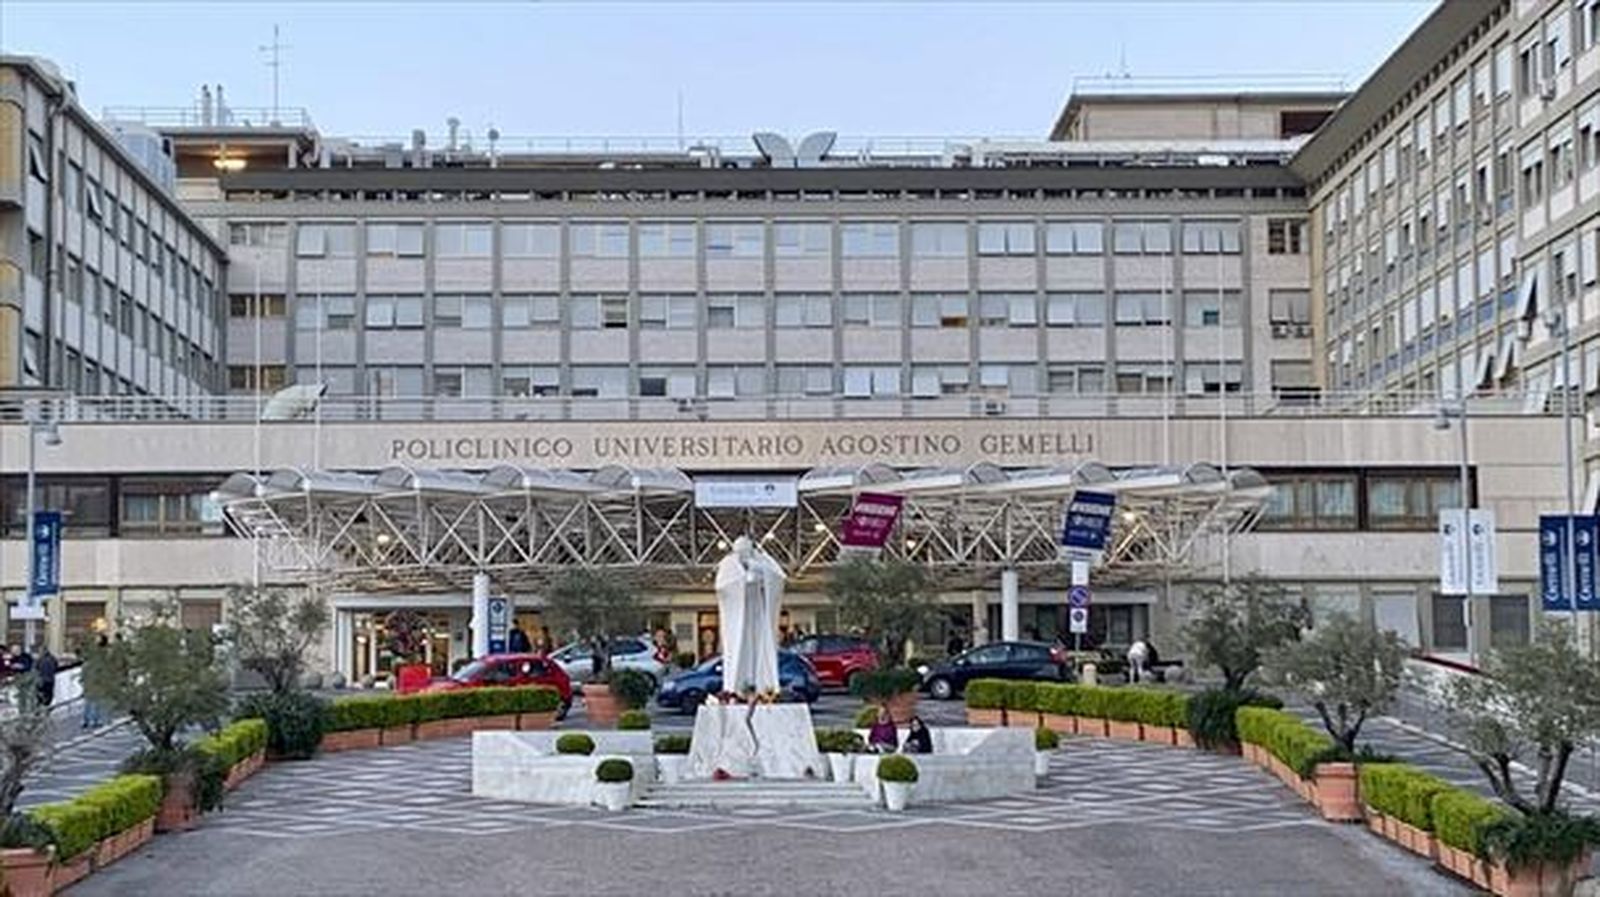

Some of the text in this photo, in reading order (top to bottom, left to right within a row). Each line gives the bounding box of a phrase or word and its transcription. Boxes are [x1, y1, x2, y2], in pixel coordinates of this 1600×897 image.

[391, 433, 1094, 460] POLICLINICO UNIVERSITARIO AGOSTINO GEMELLI
